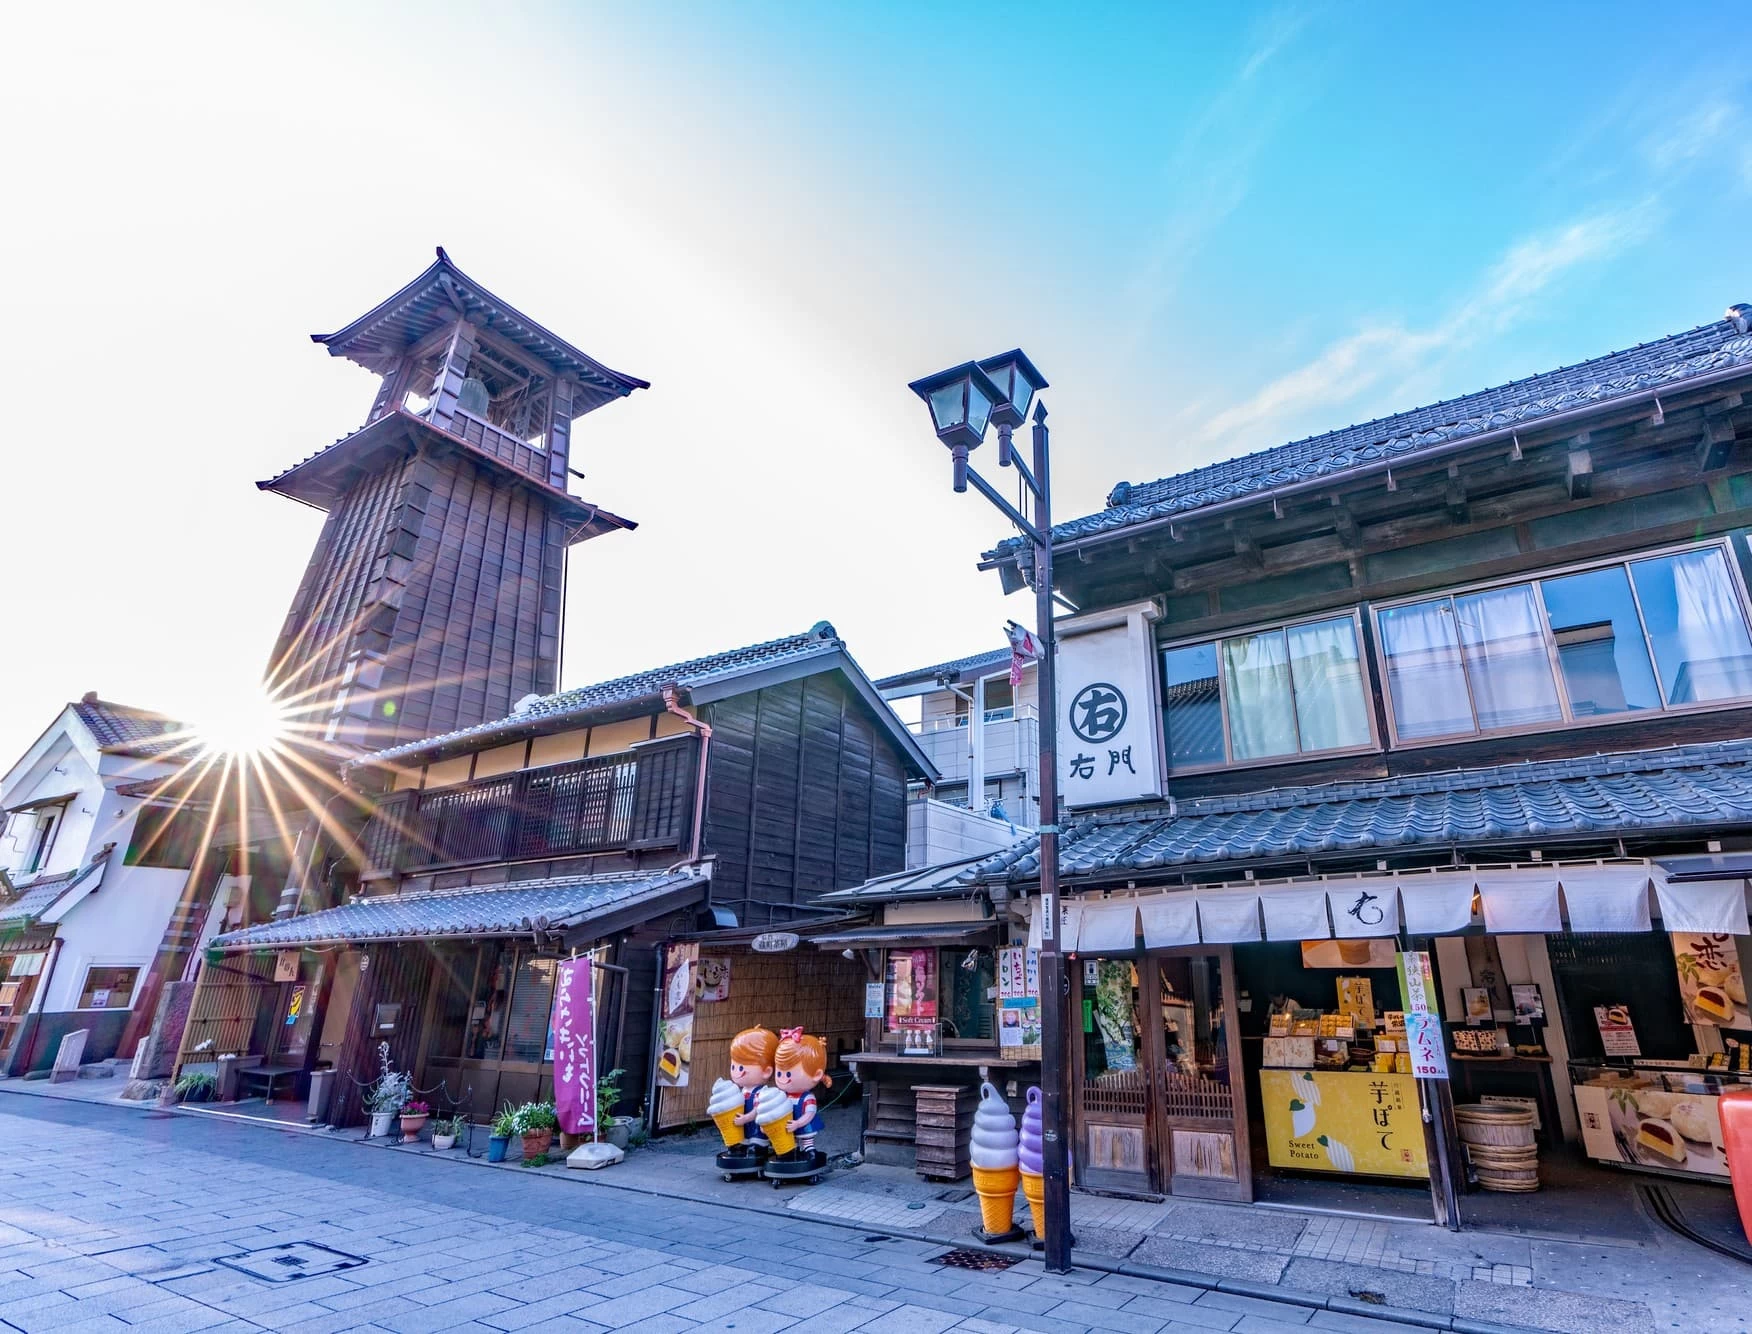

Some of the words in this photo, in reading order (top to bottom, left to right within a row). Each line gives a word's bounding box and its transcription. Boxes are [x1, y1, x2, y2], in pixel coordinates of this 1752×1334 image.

[1077, 688, 1121, 736] 右
[1069, 744, 1136, 780] 右門
[902, 1016, 913, 1024] Soft
[914, 1016, 932, 1024] Cream
[1415, 1016, 1435, 1062] ラムネ
[1369, 1081, 1395, 1151] 芋ぽて
[1288, 1139, 1316, 1150] Sweet
[1289, 1149, 1319, 1160] Potato
